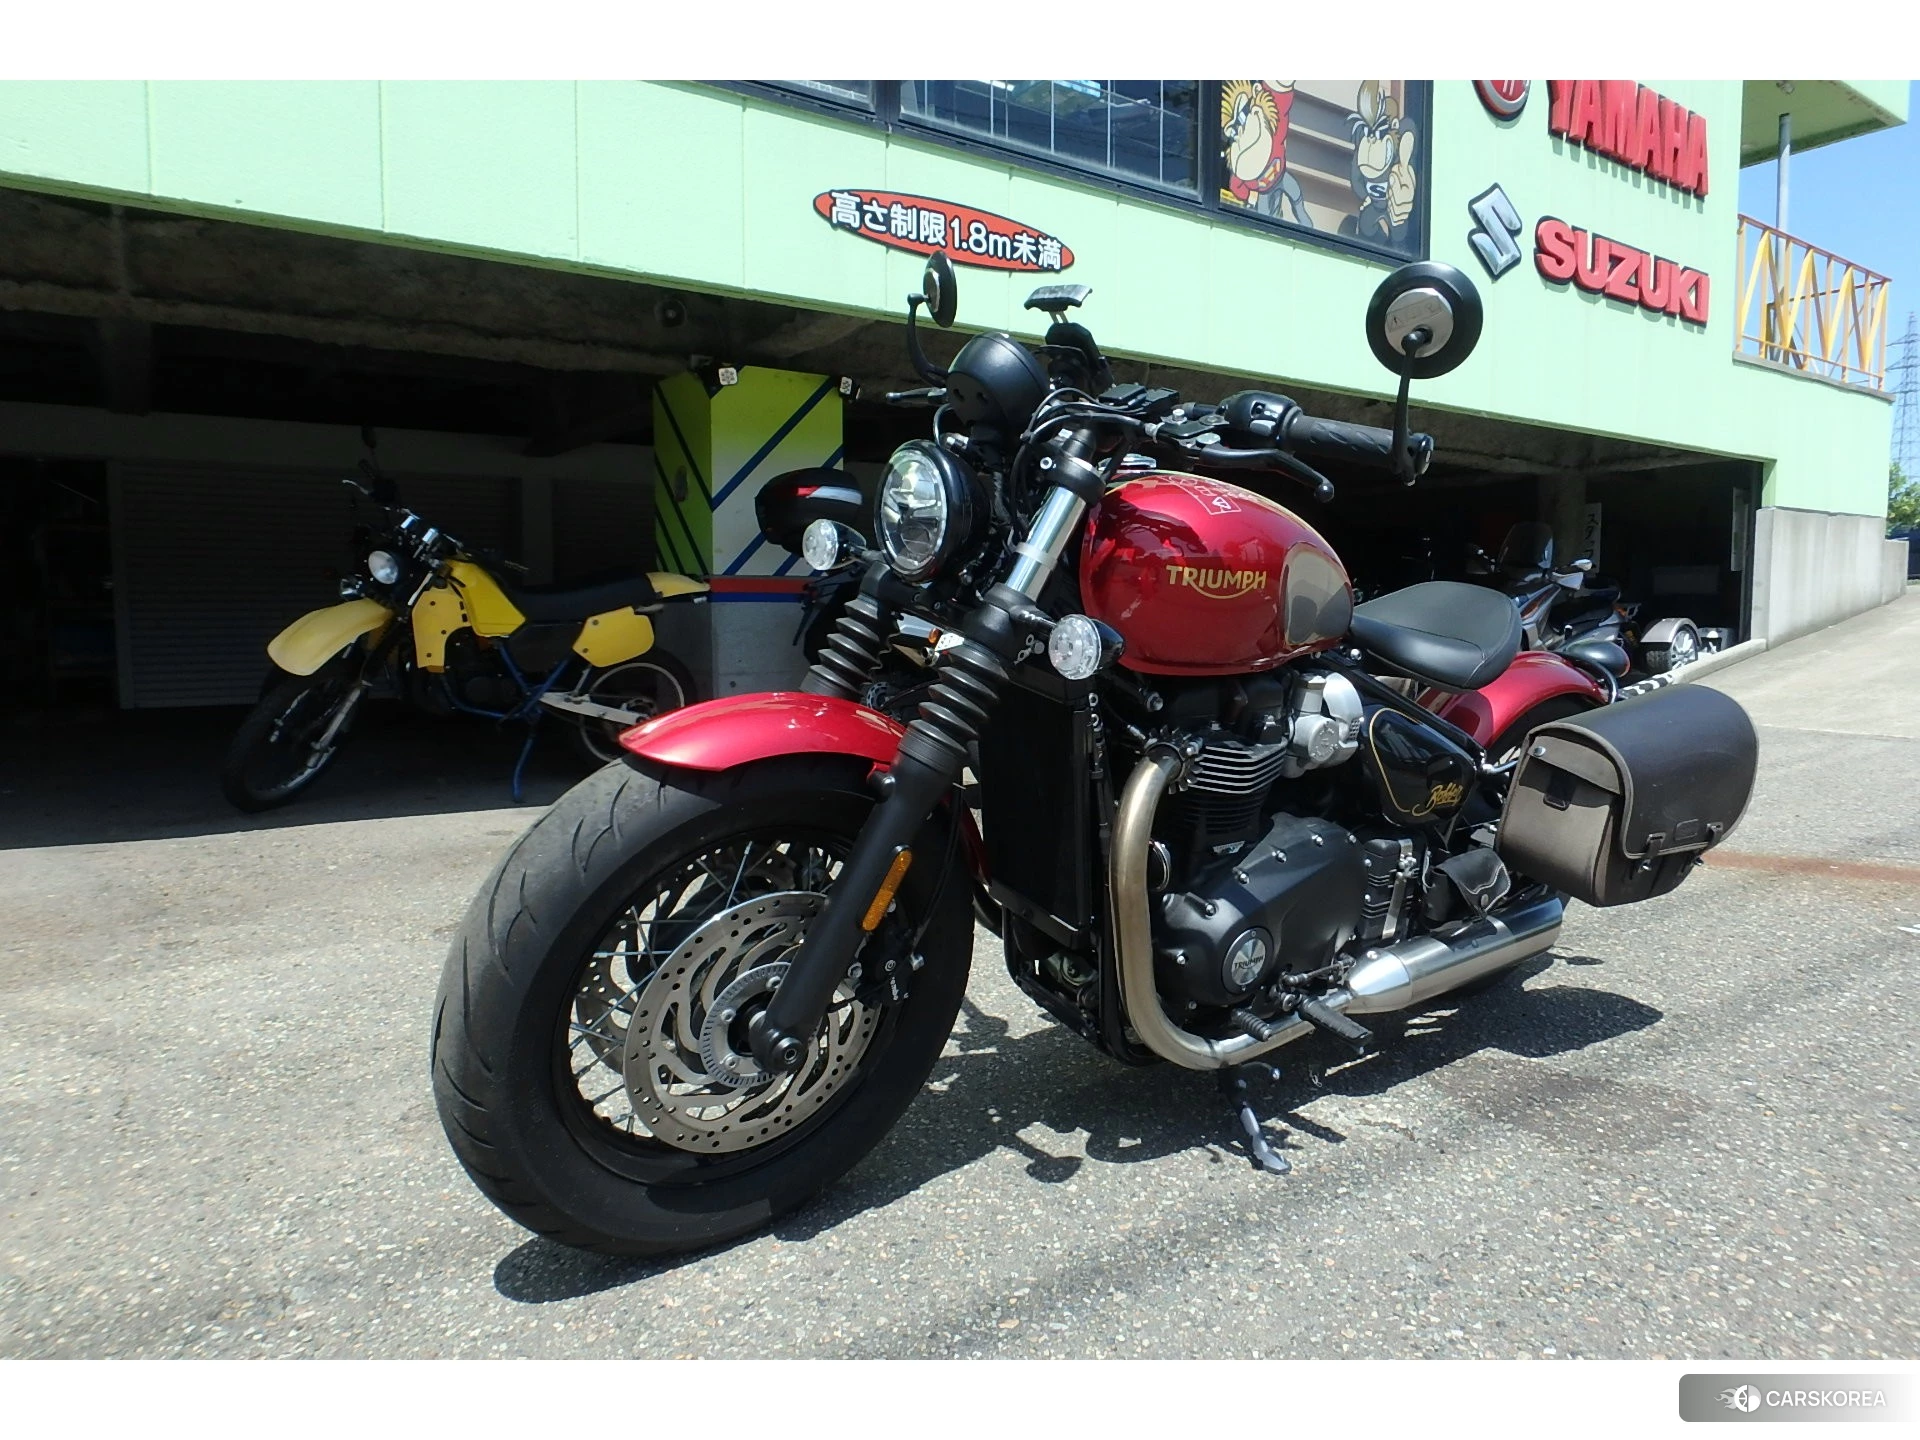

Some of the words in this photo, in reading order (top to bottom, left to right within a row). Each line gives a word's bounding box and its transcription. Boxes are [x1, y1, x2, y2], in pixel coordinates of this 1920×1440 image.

[1548, 80, 1708, 197] YAMAHA
[831, 191, 1062, 270] 高さ制限1.8m未満
[1535, 218, 1710, 324] SUZUKI
[1166, 565, 1267, 599] TRIUMPH
